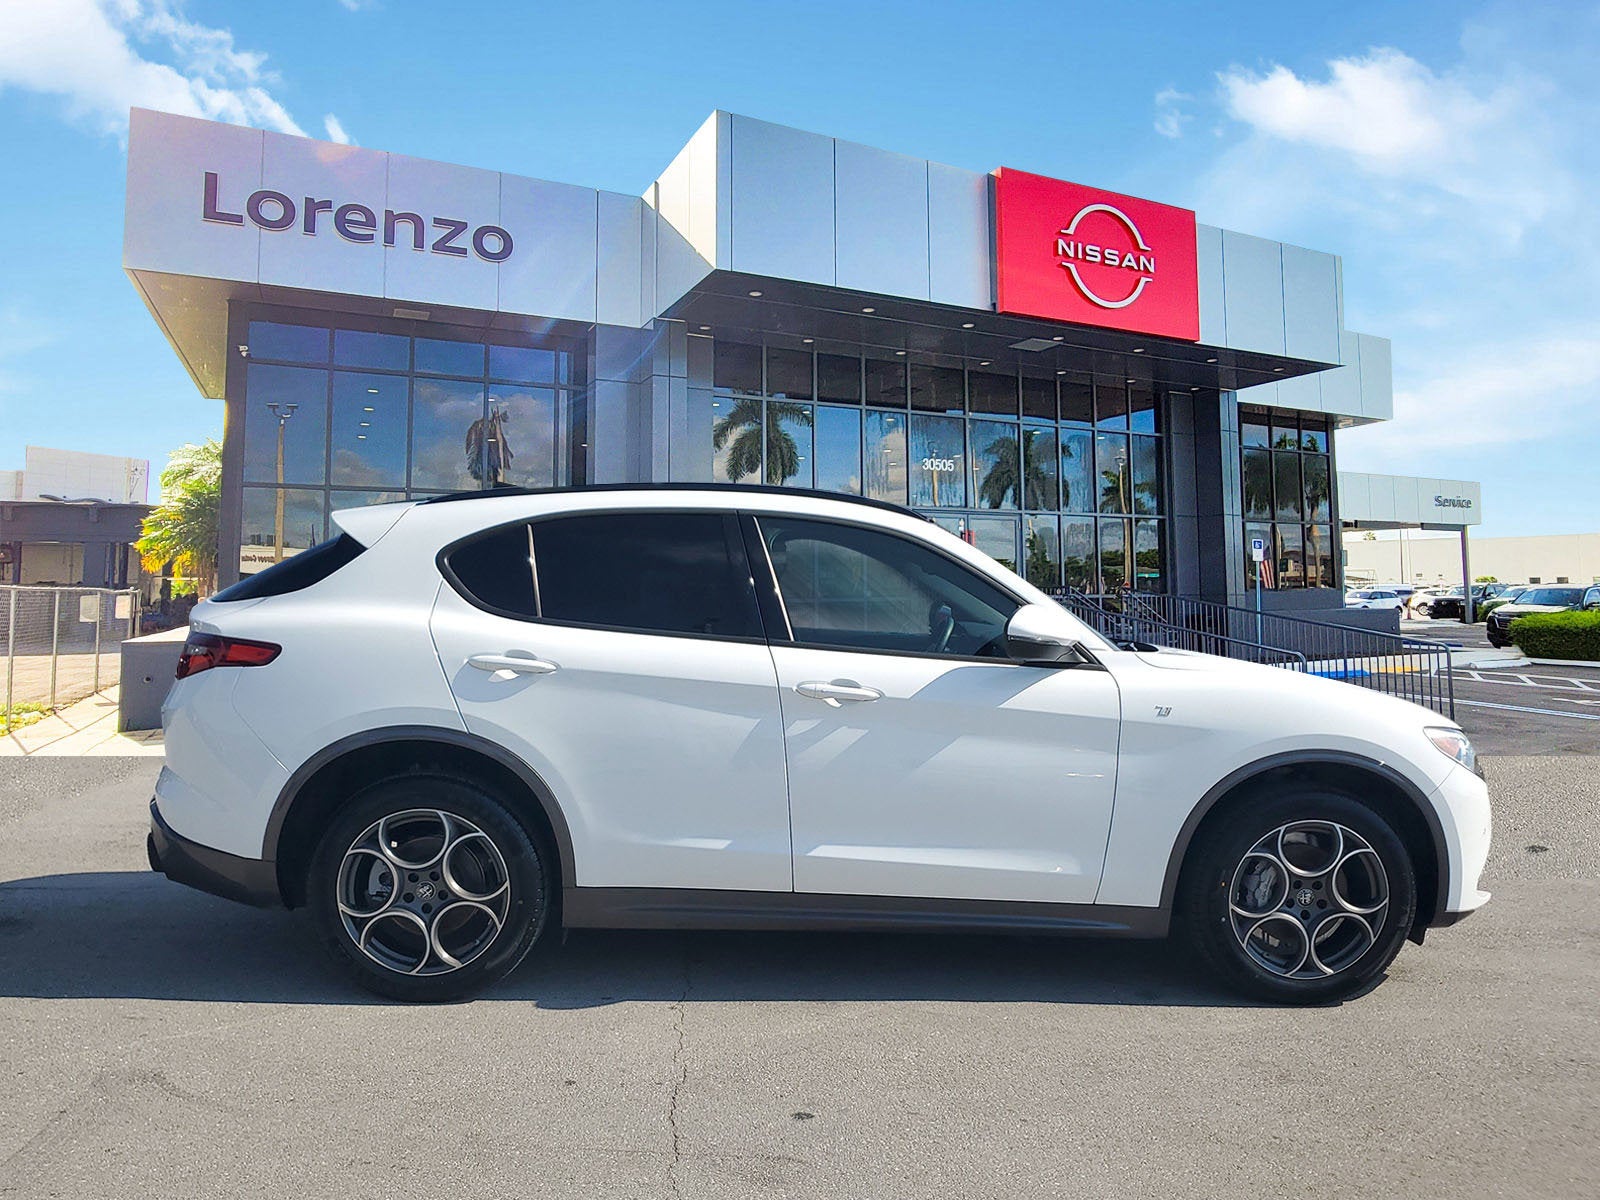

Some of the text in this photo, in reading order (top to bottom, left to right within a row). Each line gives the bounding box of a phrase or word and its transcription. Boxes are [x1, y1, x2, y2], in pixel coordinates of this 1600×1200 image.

[202, 171, 514, 262] Lorenzo
[1057, 238, 1155, 273] NISSAN
[922, 458, 954, 471] 30505
[1434, 495, 1472, 508] Service
